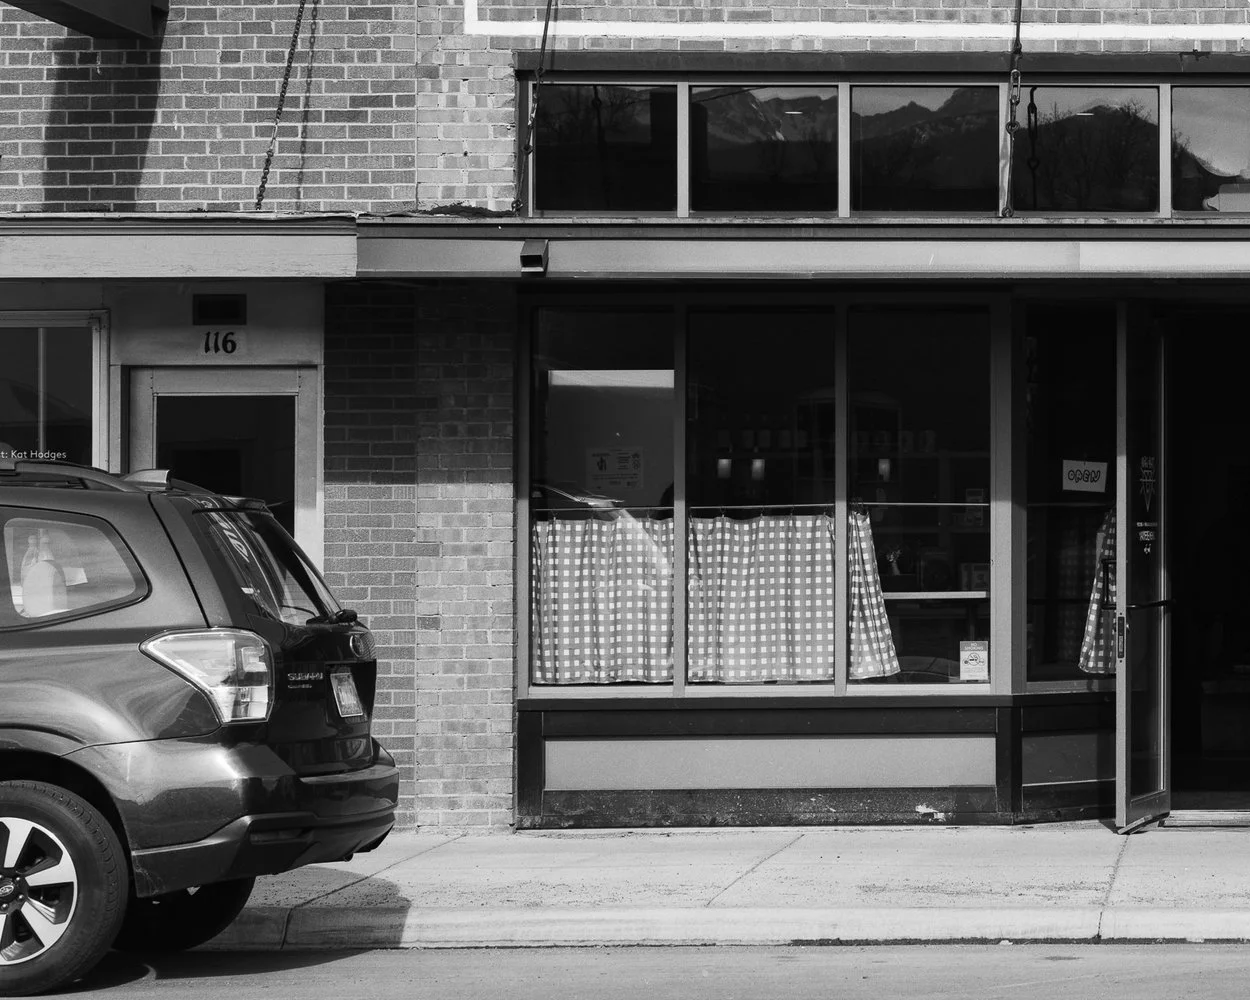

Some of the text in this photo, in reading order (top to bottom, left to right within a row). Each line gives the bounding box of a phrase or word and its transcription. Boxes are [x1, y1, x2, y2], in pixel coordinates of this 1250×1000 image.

[204, 331, 237, 354] 116
[11, 449, 28, 459] Kat
[30, 449, 67, 461] Hodges
[1067, 468, 1101, 484] OPEN
